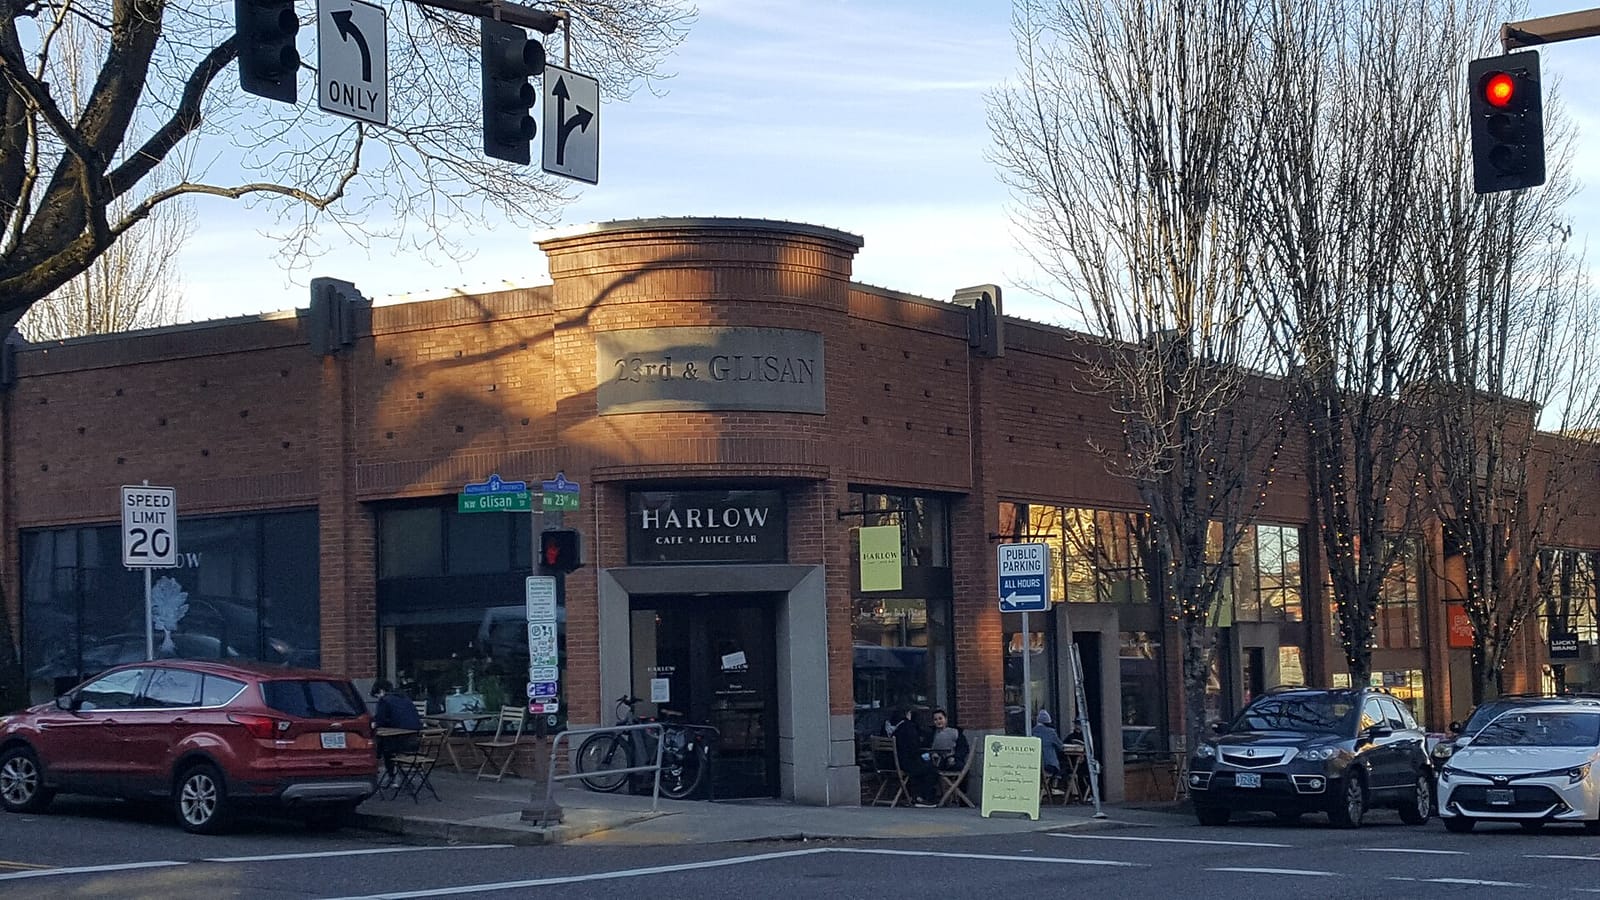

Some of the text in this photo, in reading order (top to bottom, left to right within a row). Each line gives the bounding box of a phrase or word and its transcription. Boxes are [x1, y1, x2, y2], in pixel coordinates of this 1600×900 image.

[329, 80, 378, 113] ONLY
[614, 355, 815, 384] 23rd & GLISAN
[127, 494, 170, 508] SPEED
[480, 495, 512, 508] Glisan
[132, 512, 166, 524] LIMIT
[642, 507, 769, 529] HARLOW
[129, 528, 170, 558] 20
[656, 535, 757, 545] CAFE JUICE BAR
[863, 551, 897, 560] HARLOW
[1006, 548, 1037, 560] PUBLIC
[1003, 560, 1041, 572] PARKING
[1004, 578, 1041, 589] ALL HOURS
